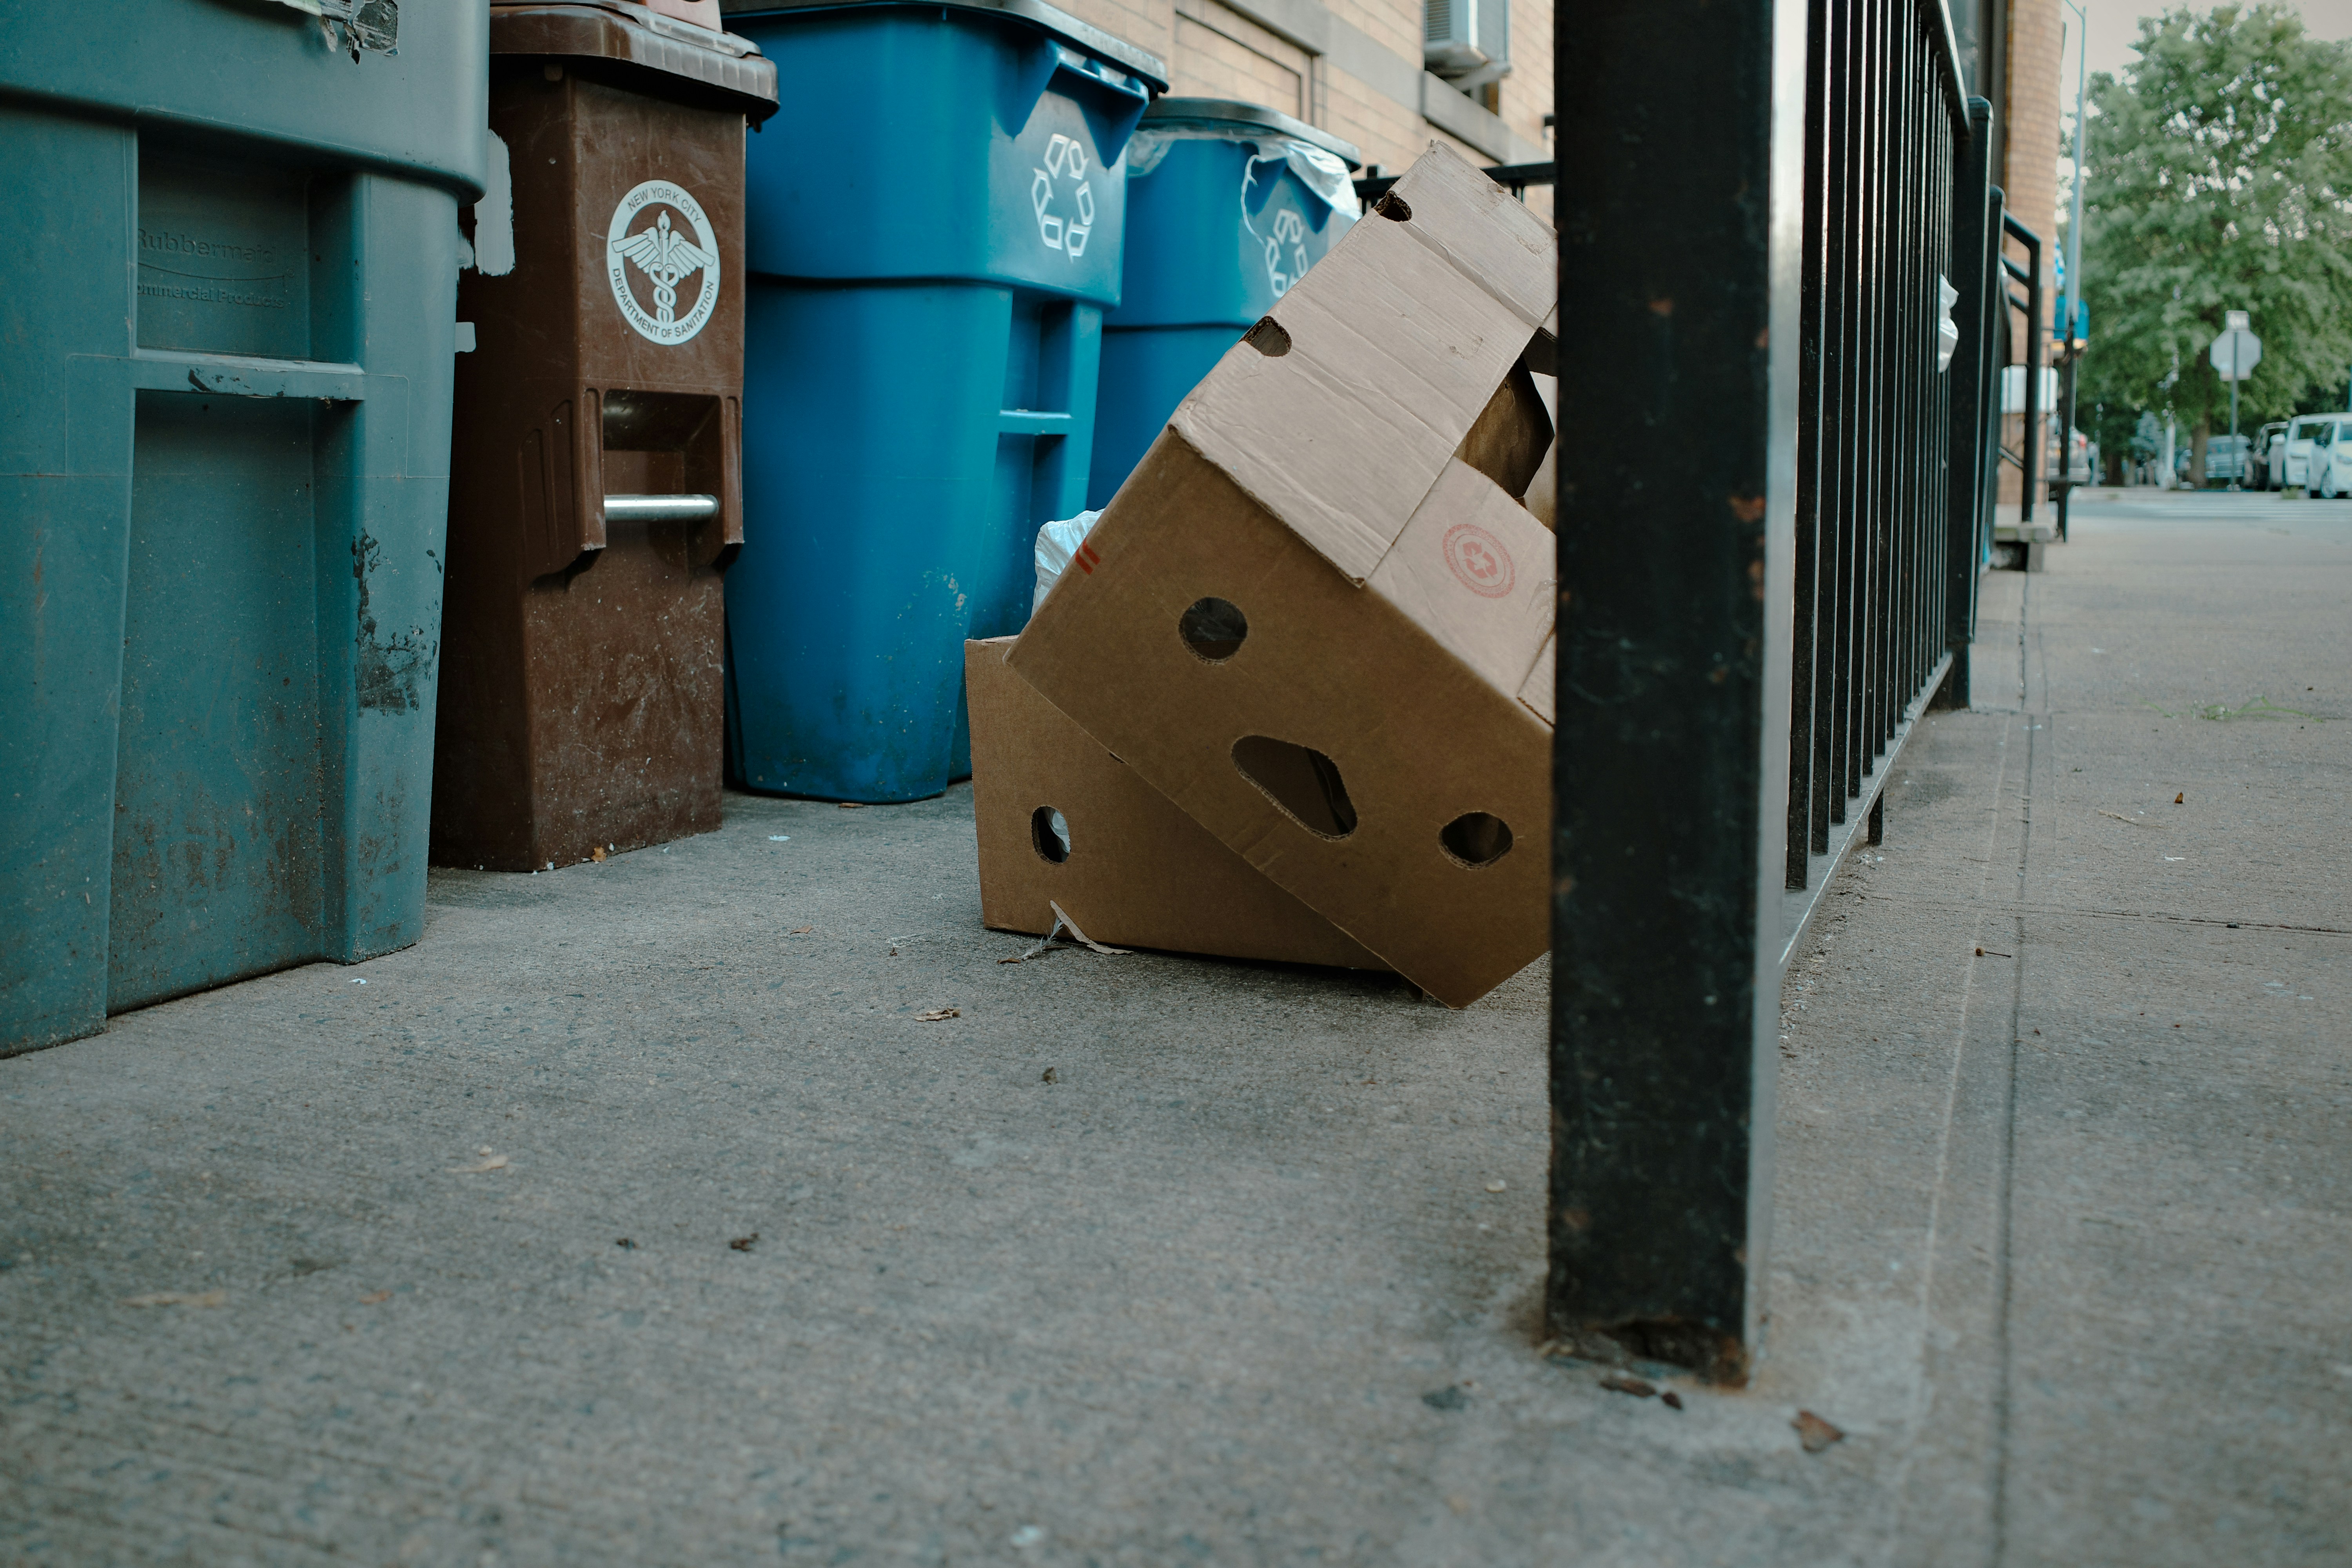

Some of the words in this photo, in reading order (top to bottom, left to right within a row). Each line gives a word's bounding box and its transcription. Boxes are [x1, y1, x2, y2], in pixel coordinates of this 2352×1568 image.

[628, 189, 648, 212] NEW
[652, 187, 679, 203] YORK
[681, 199, 702, 223] CITY
[138, 228, 276, 264] Rubbermaid
[138, 284, 213, 301] ommercial
[218, 288, 284, 309] Products
[613, 268, 659, 336] DEPARTMENT
[661, 328, 672, 338] OF
[675, 281, 715, 337] SANITATION
